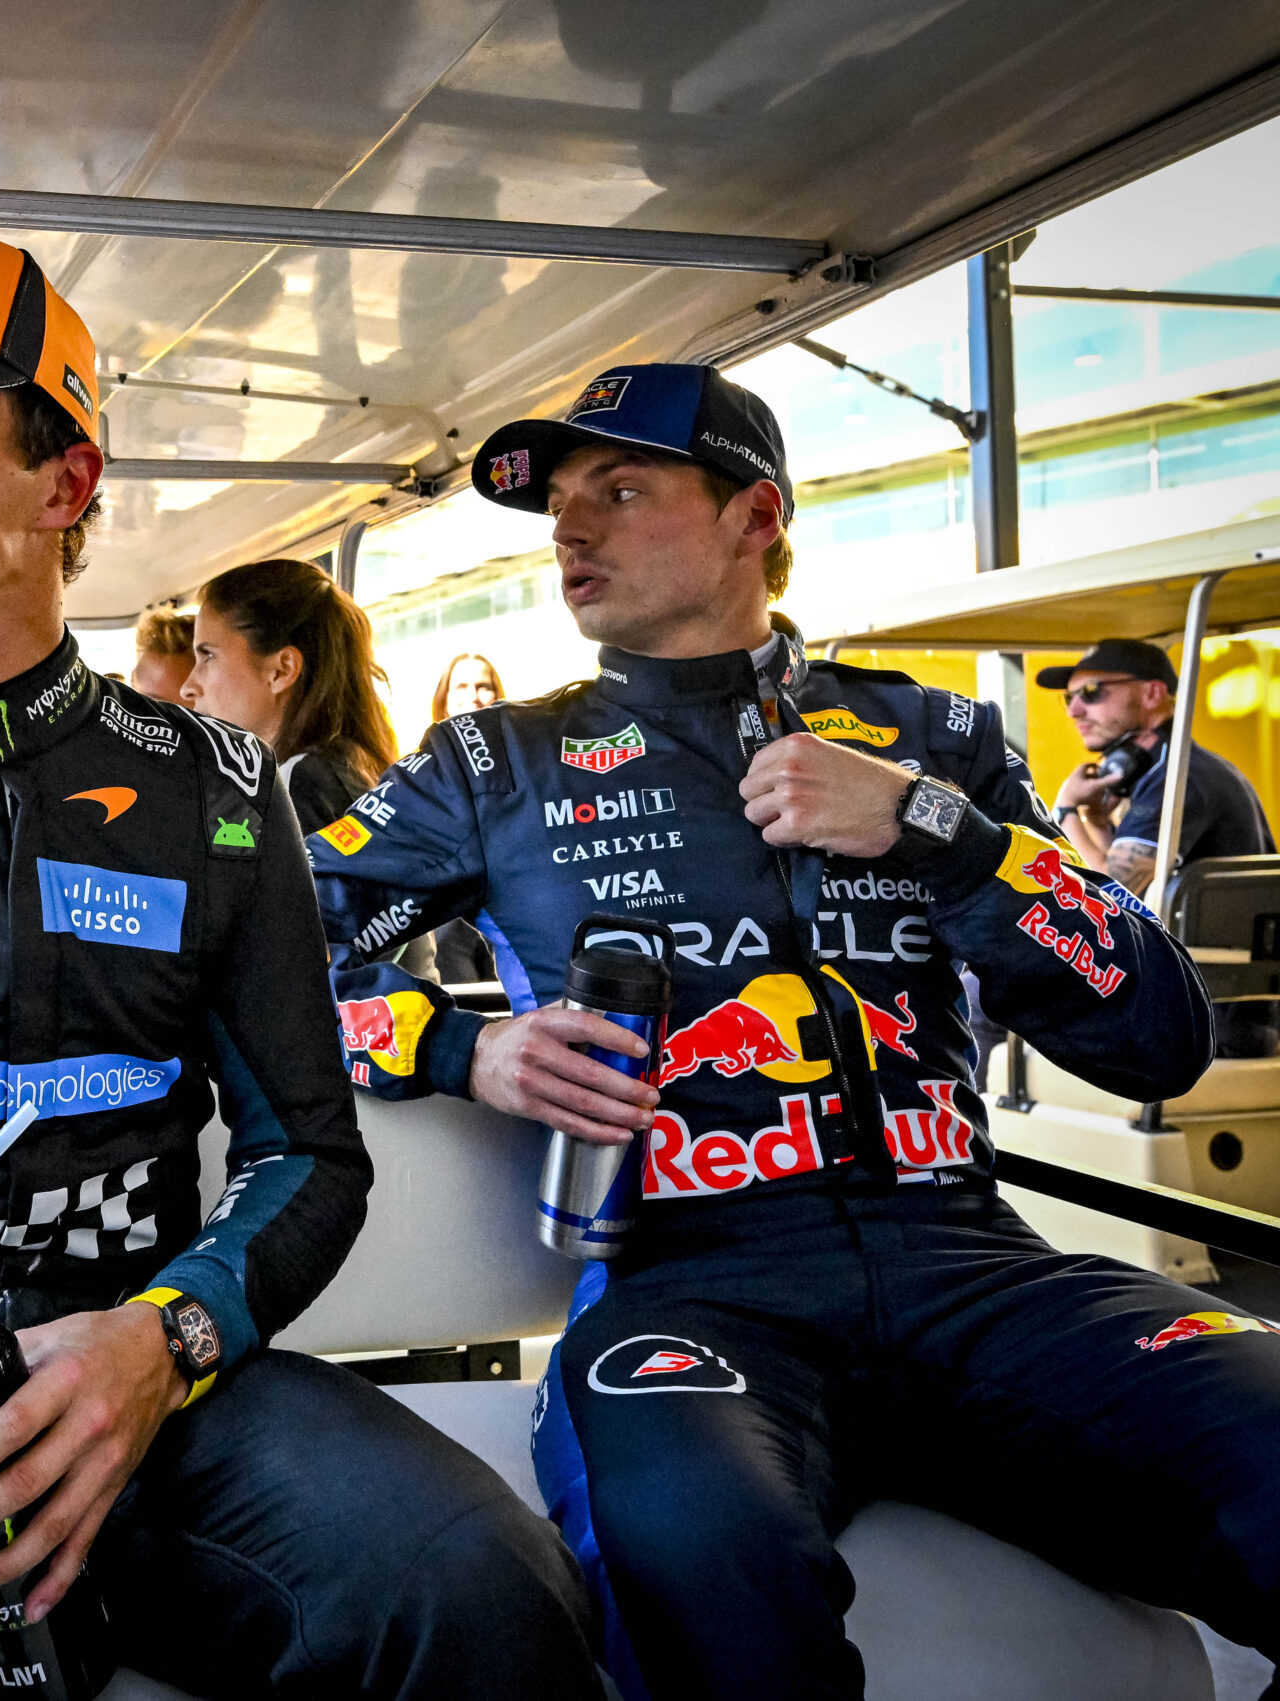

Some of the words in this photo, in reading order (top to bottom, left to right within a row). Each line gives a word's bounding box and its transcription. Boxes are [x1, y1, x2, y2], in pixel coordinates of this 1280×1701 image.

[700, 431, 776, 479] ALPHATAURI
[100, 715, 120, 735] FOR
[122, 730, 143, 748] THE
[146, 741, 177, 757] STAY
[109, 700, 174, 740] Hilton
[451, 715, 495, 773] sparco
[566, 747, 641, 771] HEUER
[570, 731, 637, 753] TAG
[544, 789, 638, 828] Mobil
[552, 831, 684, 864] CARLYLE
[582, 868, 664, 901] VISA
[625, 892, 687, 910] INFINITE
[1016, 901, 1084, 963] Red
[1071, 940, 1128, 998] Bull
[641, 1092, 824, 1200] Red
